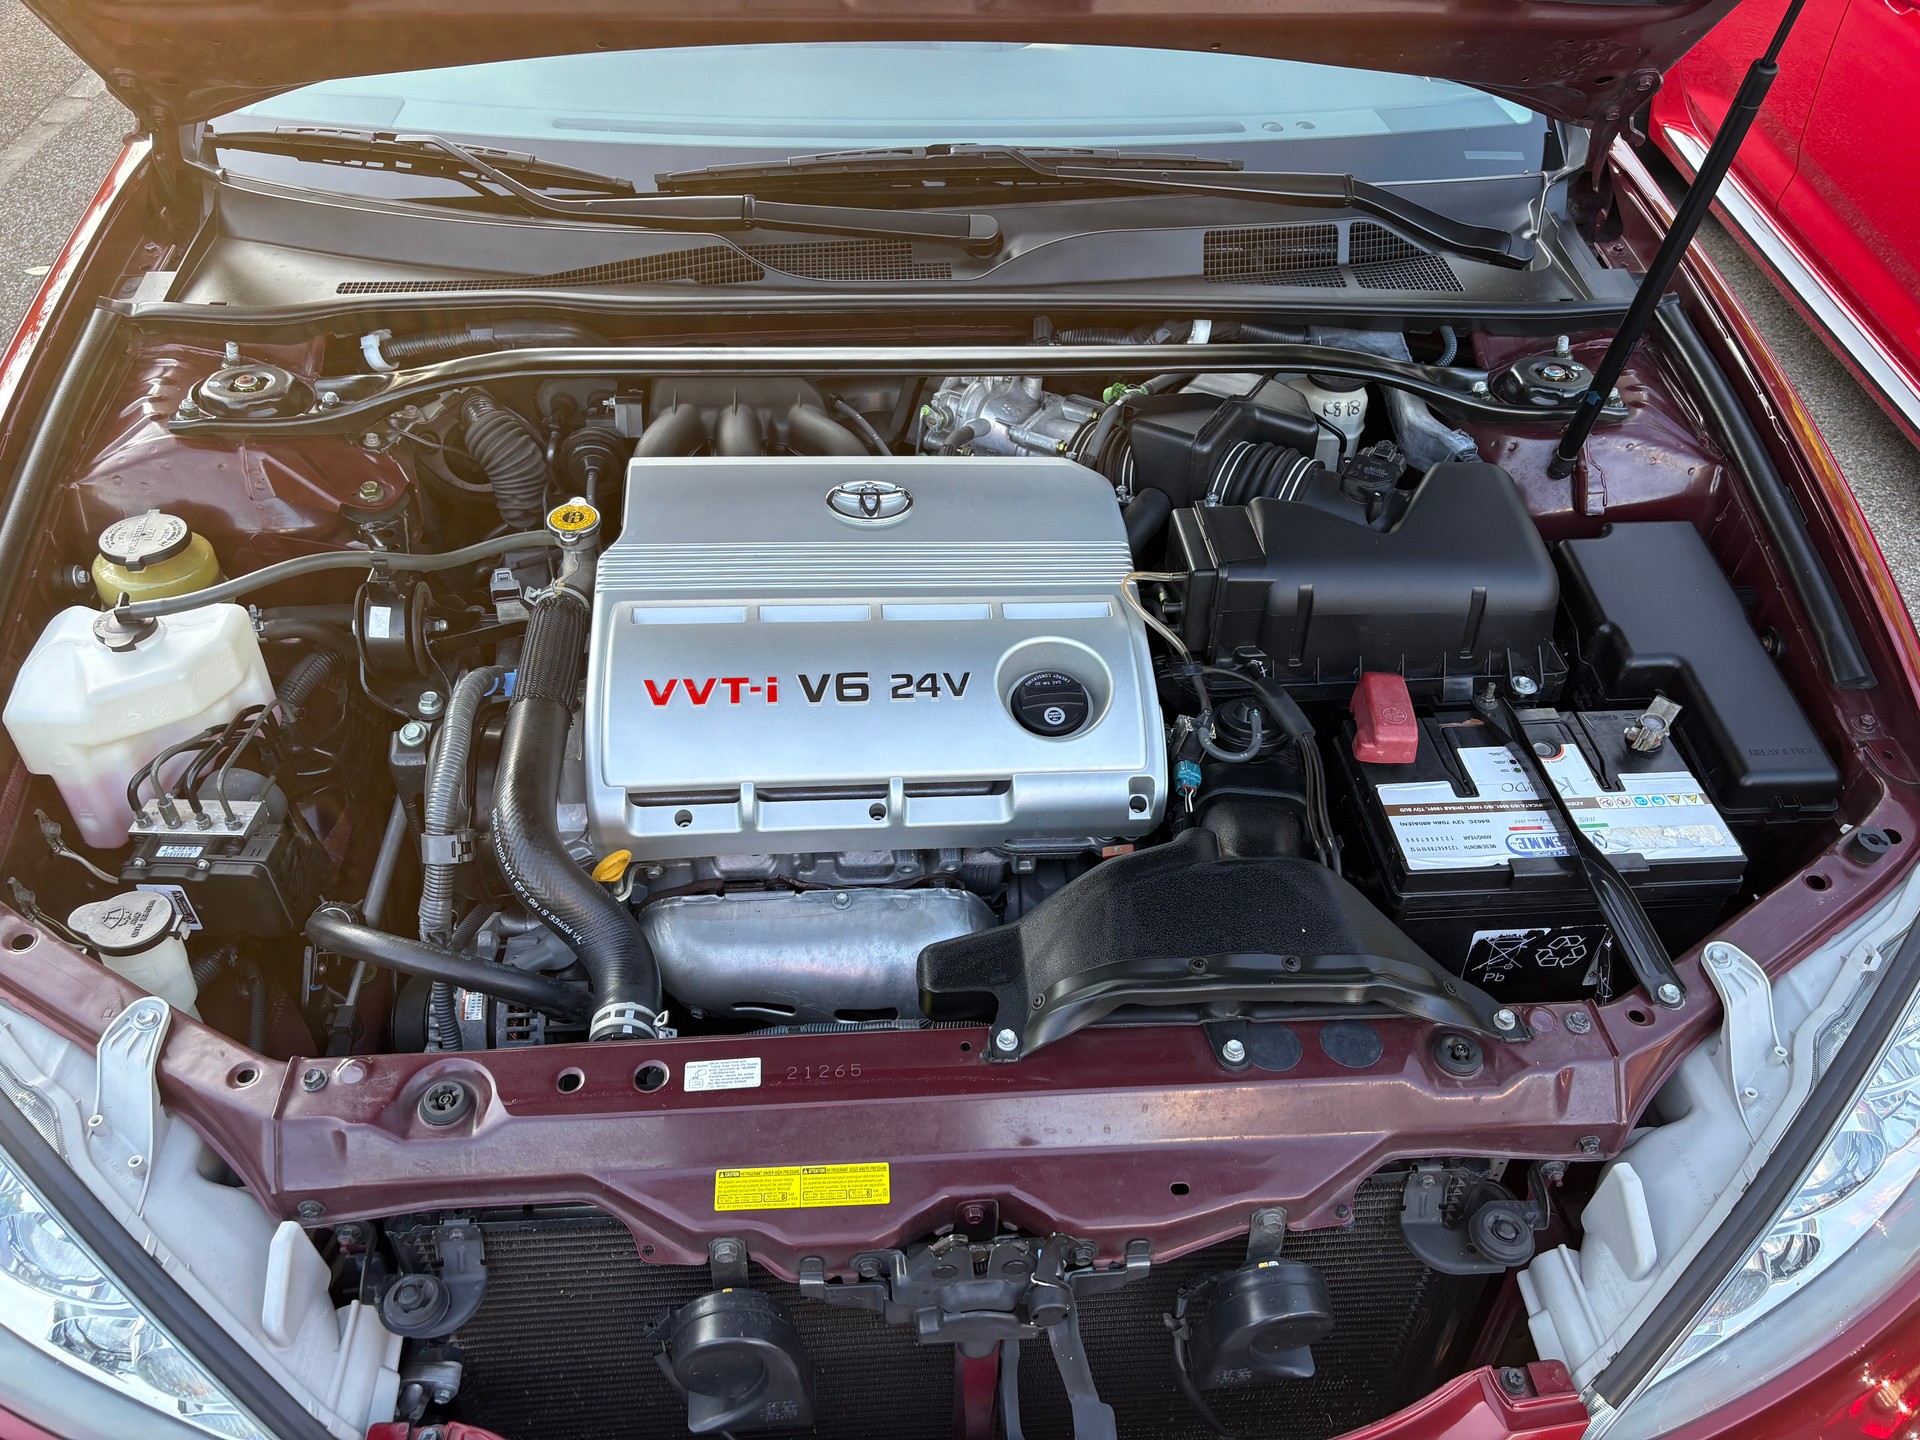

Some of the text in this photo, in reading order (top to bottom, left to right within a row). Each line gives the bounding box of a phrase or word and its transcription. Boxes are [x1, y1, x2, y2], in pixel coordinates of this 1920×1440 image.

[644, 672, 971, 706] VVT-i V6 24V
[1483, 973, 1505, 982] Pb
[787, 1064, 862, 1080] 21265
